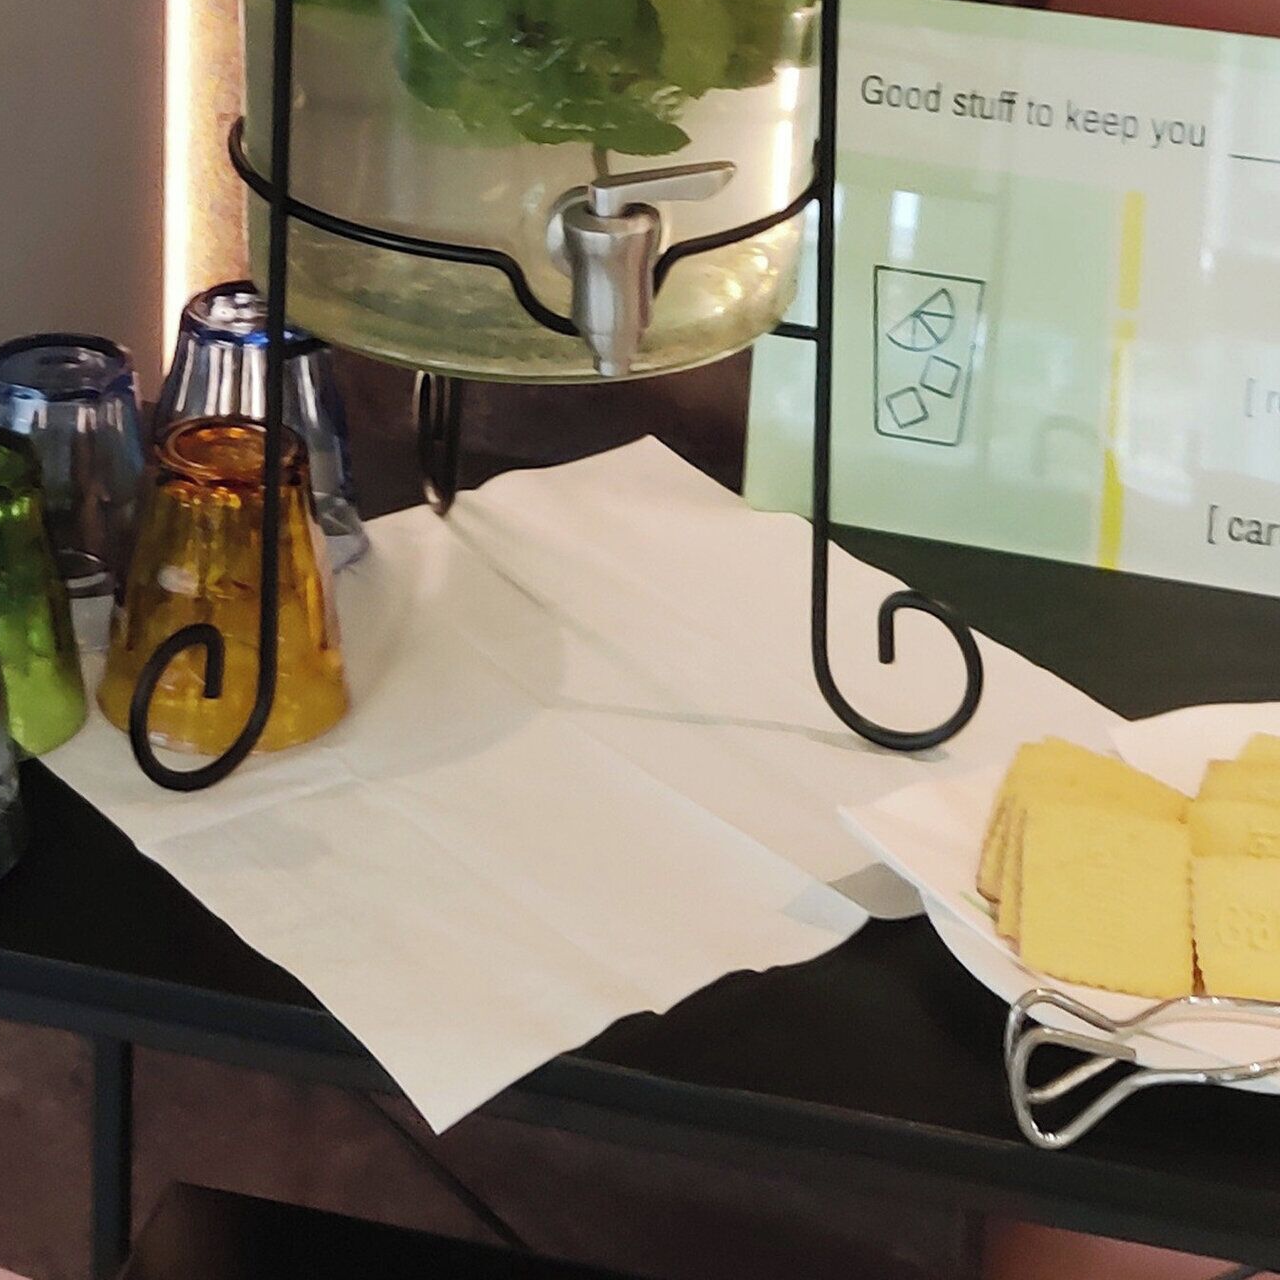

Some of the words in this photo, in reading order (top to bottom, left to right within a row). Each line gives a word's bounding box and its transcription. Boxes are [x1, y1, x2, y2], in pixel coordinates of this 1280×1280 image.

[860, 74, 943, 113] Good
[952, 89, 1019, 123] stuff
[1026, 100, 1054, 128] to
[1066, 99, 1139, 144] keep
[1150, 117, 1206, 149] you
